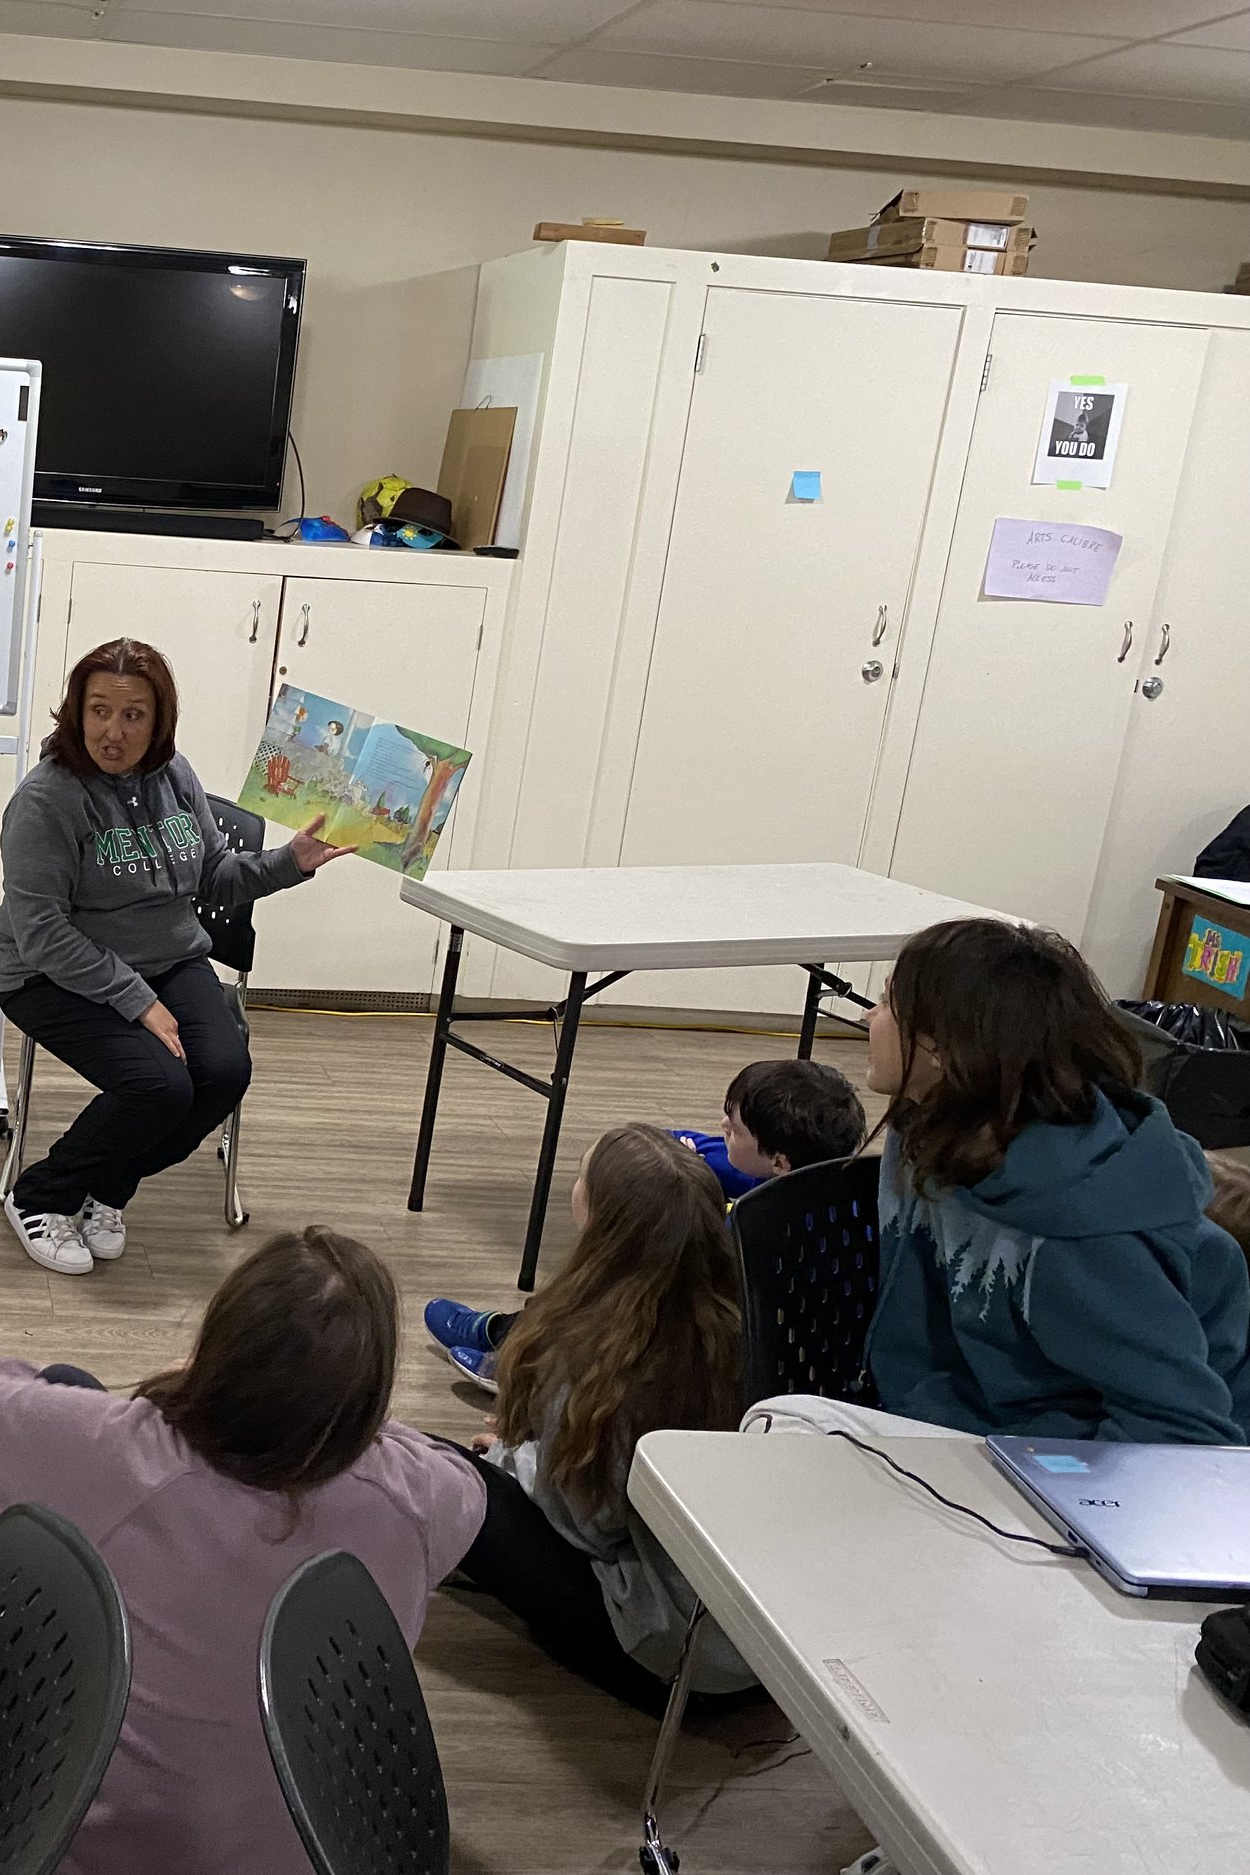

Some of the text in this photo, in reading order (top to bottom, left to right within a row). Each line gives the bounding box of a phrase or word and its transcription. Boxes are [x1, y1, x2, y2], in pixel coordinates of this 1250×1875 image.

[1073, 395, 1095, 411] YES
[1055, 440, 1096, 457] YOU DO
[78, 486, 102, 494] SAMSUNG
[1026, 529, 1104, 552] ARTS CALIBRE
[1026, 574, 1057, 583] ACCESS
[1188, 933, 1243, 983] TRISH
[1078, 1498, 1121, 1508] acer
